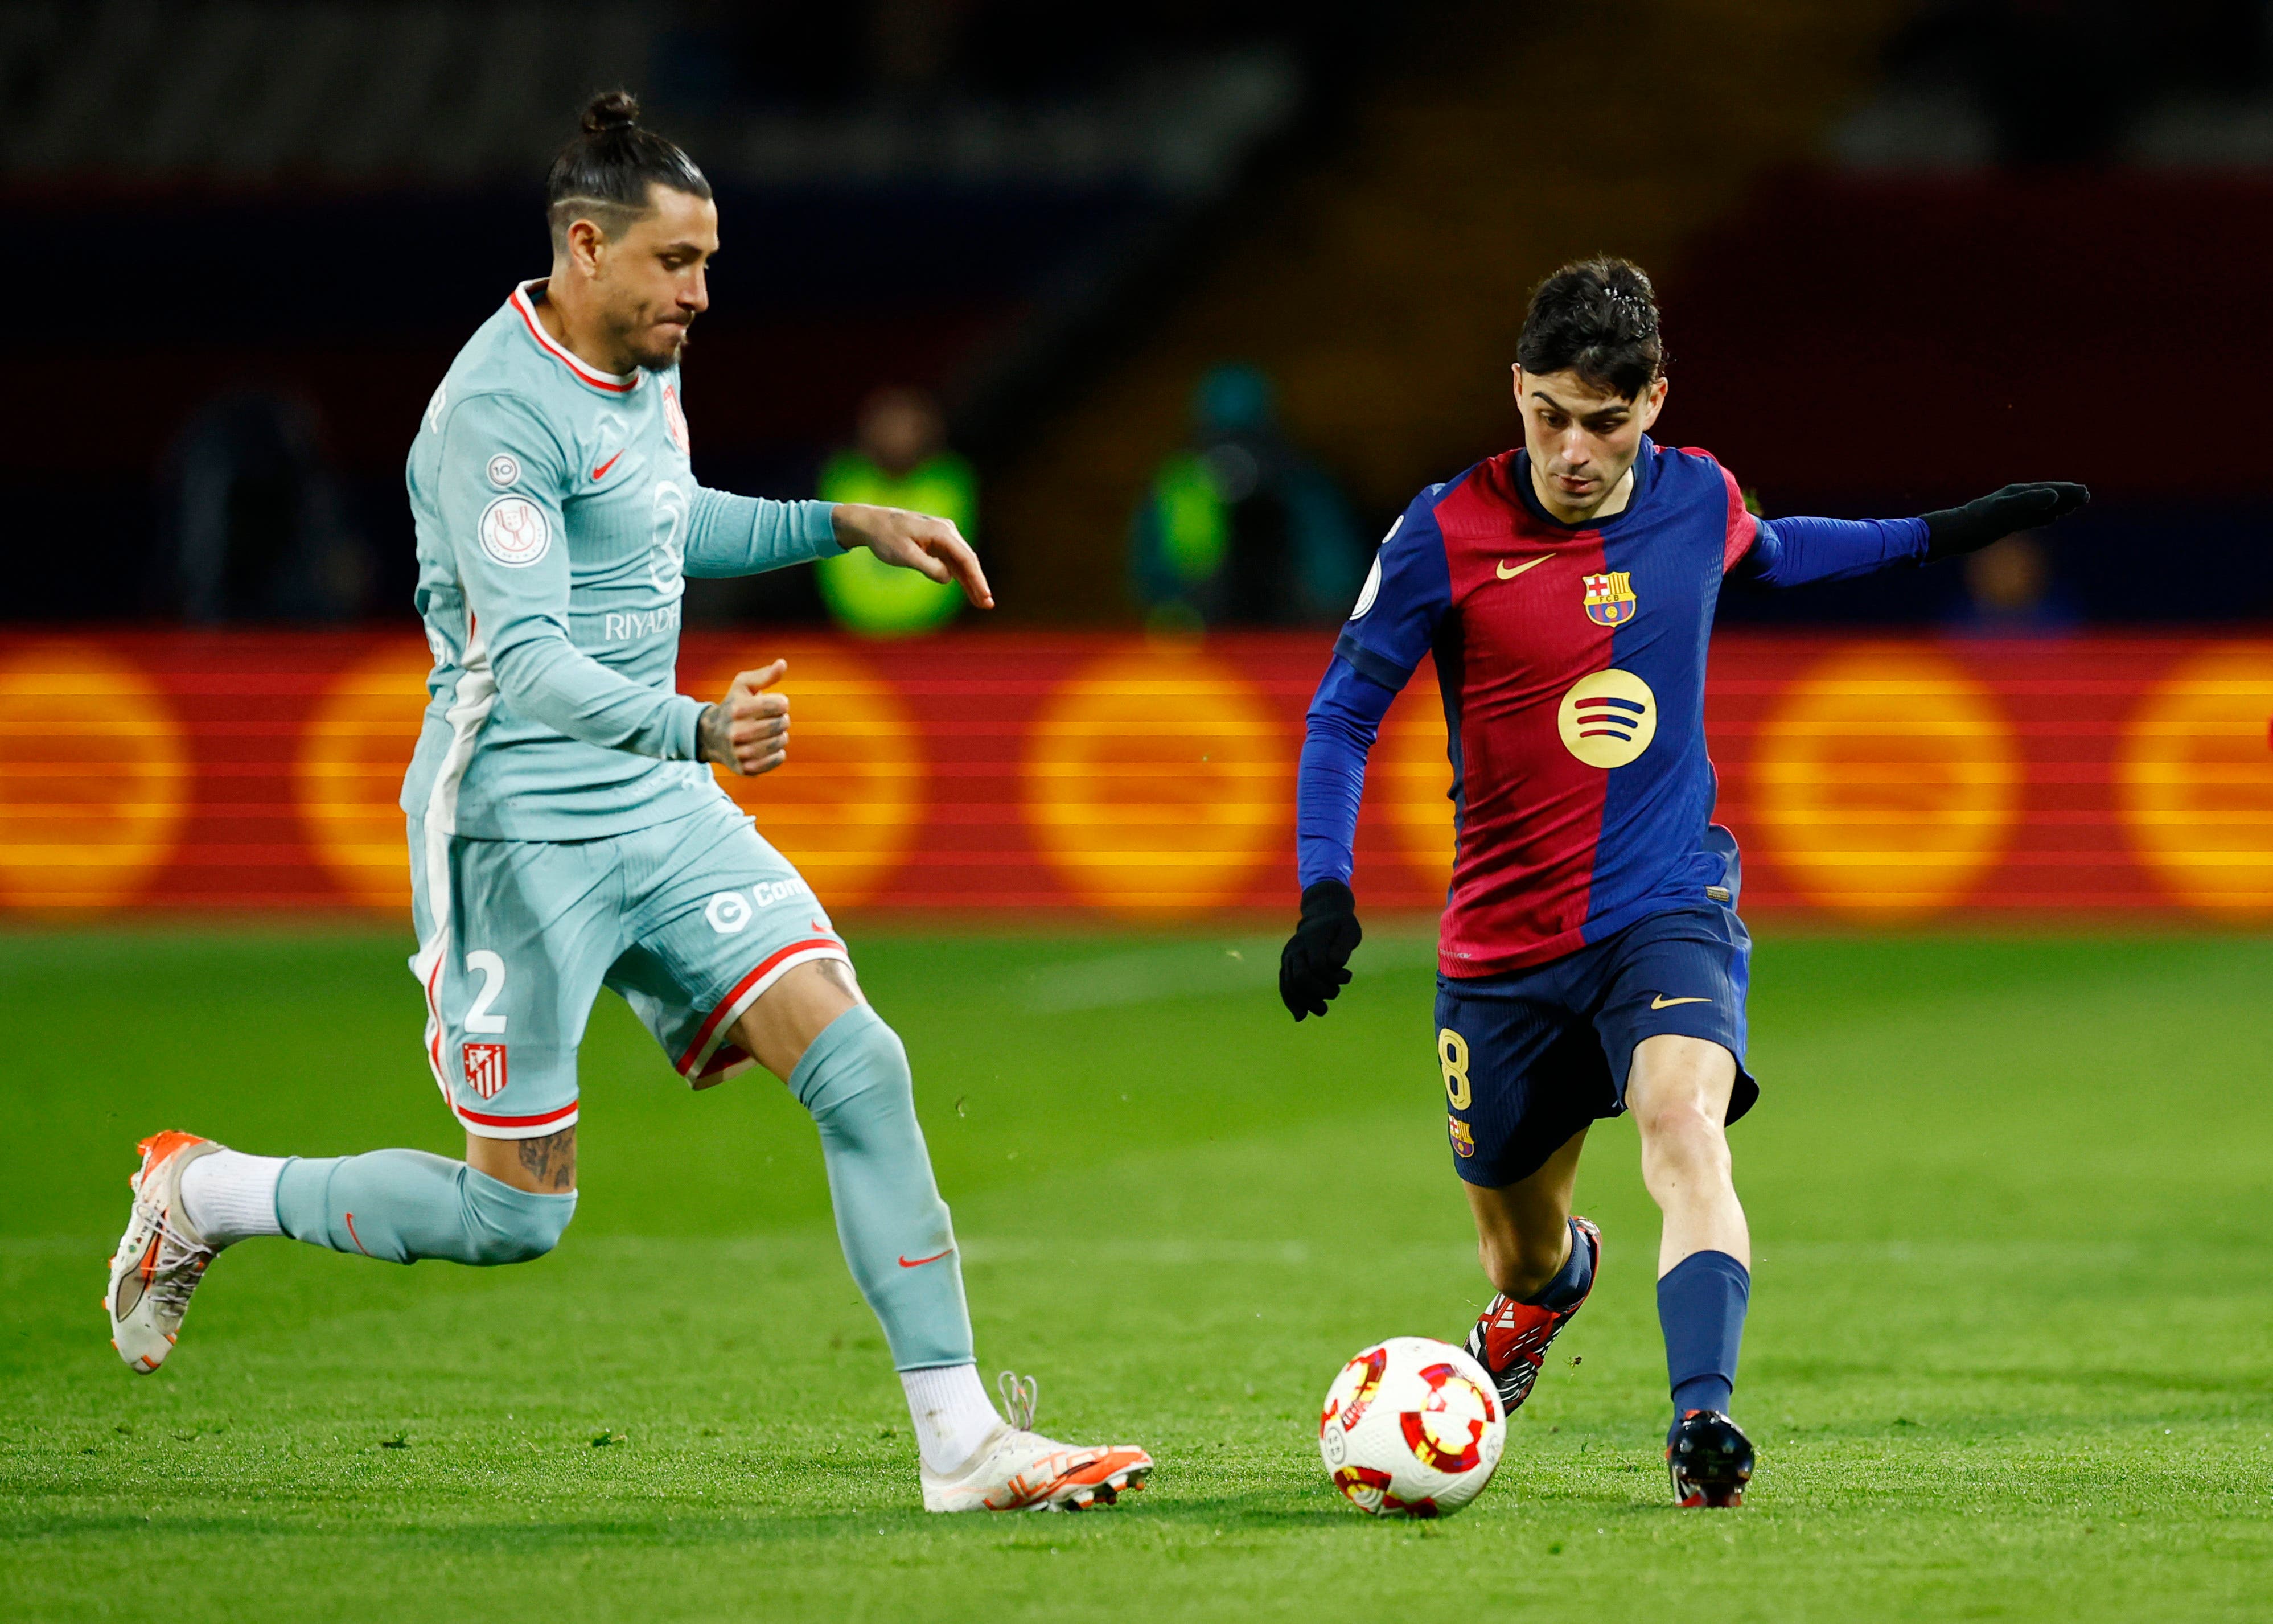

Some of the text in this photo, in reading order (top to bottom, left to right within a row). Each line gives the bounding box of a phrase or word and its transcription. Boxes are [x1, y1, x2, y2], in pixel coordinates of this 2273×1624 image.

[492, 464, 513, 476] 10
[605, 603, 681, 641] RIYADH
[464, 949, 508, 1034] 2
[1438, 1027, 1472, 1111] 8
